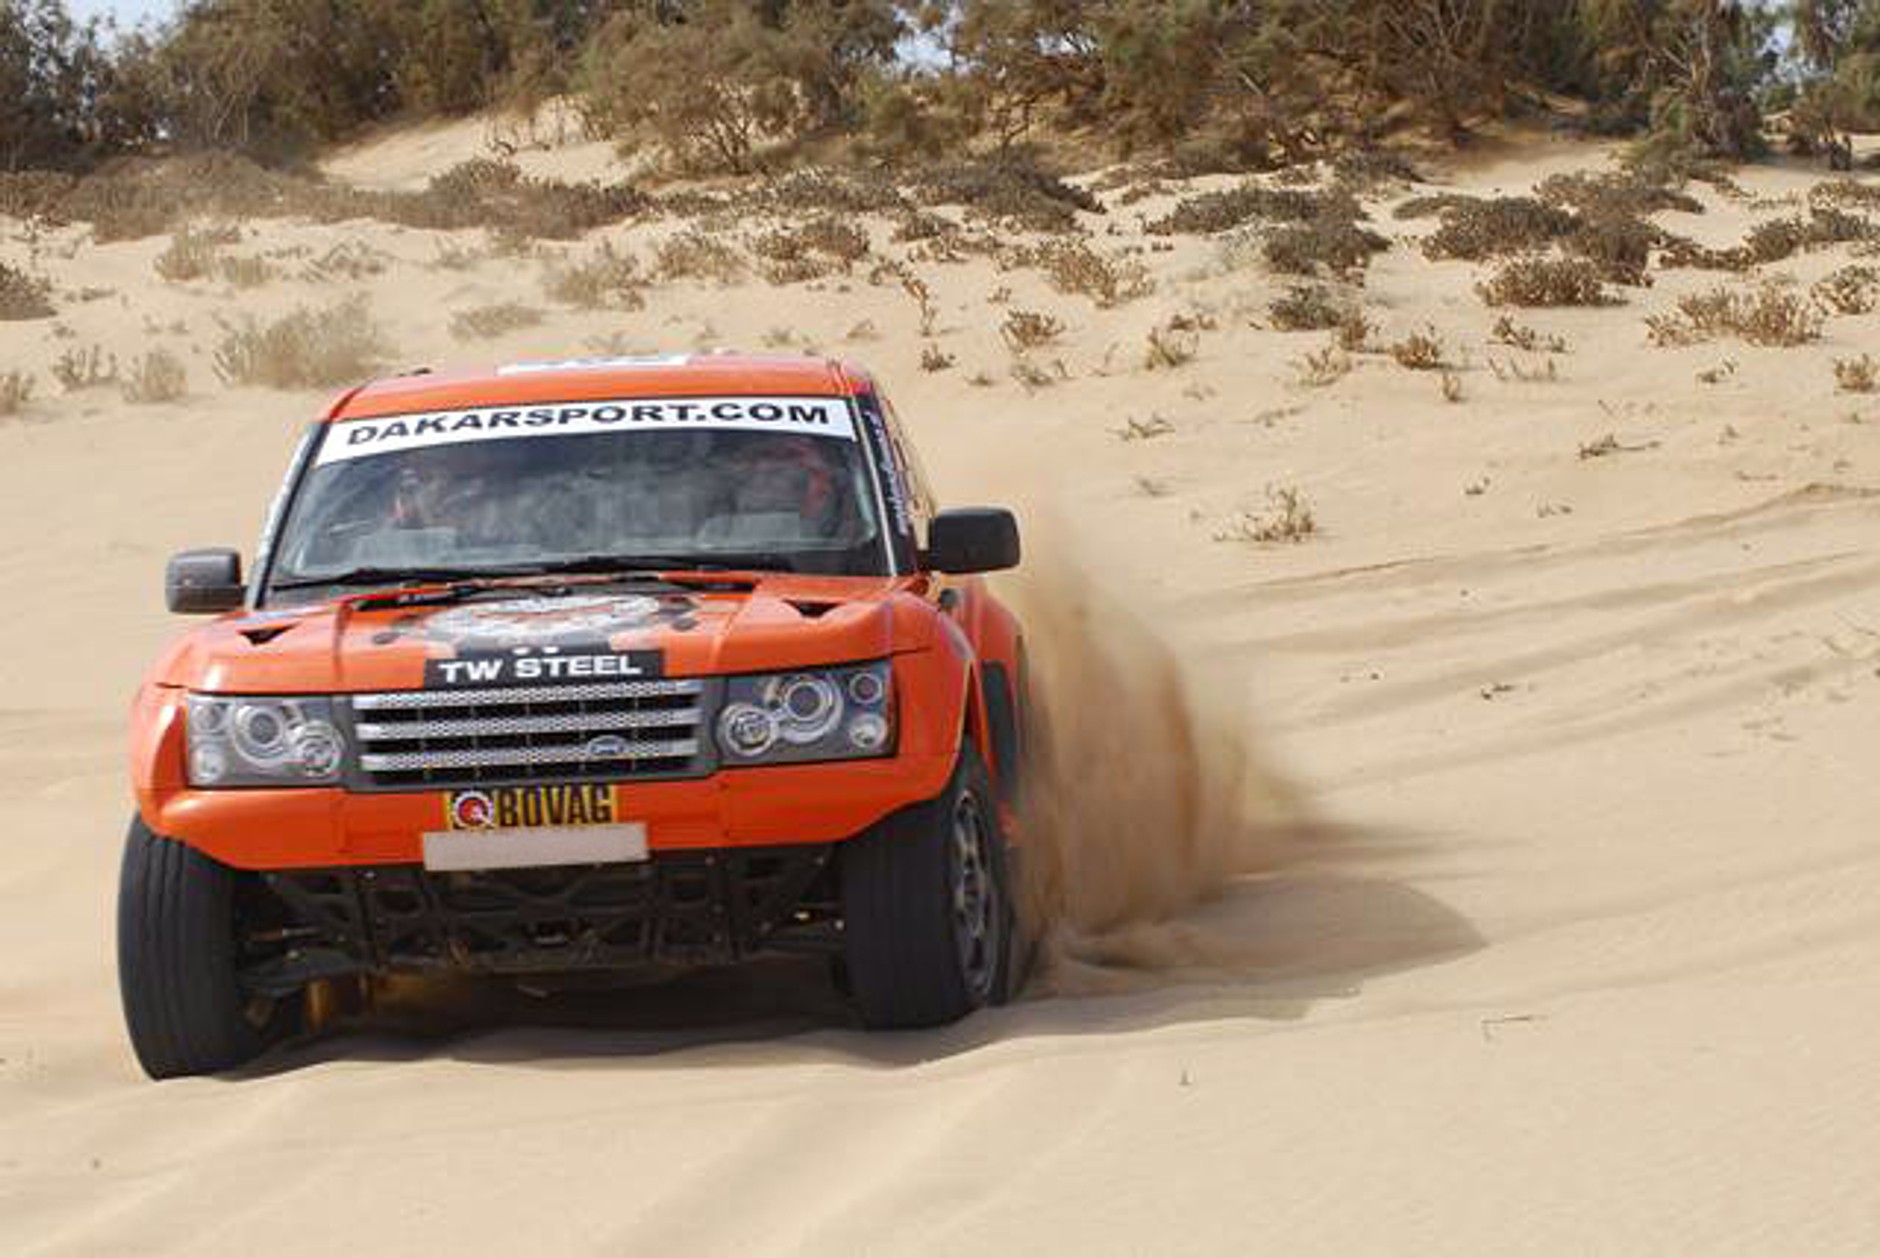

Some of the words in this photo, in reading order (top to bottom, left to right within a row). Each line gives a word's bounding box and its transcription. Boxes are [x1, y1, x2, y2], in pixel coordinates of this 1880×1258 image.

[348, 402, 830, 446] DAKARSPORT.COM
[439, 660, 503, 683] TW
[515, 655, 643, 678] STEEL
[499, 786, 613, 827] BOVAG
